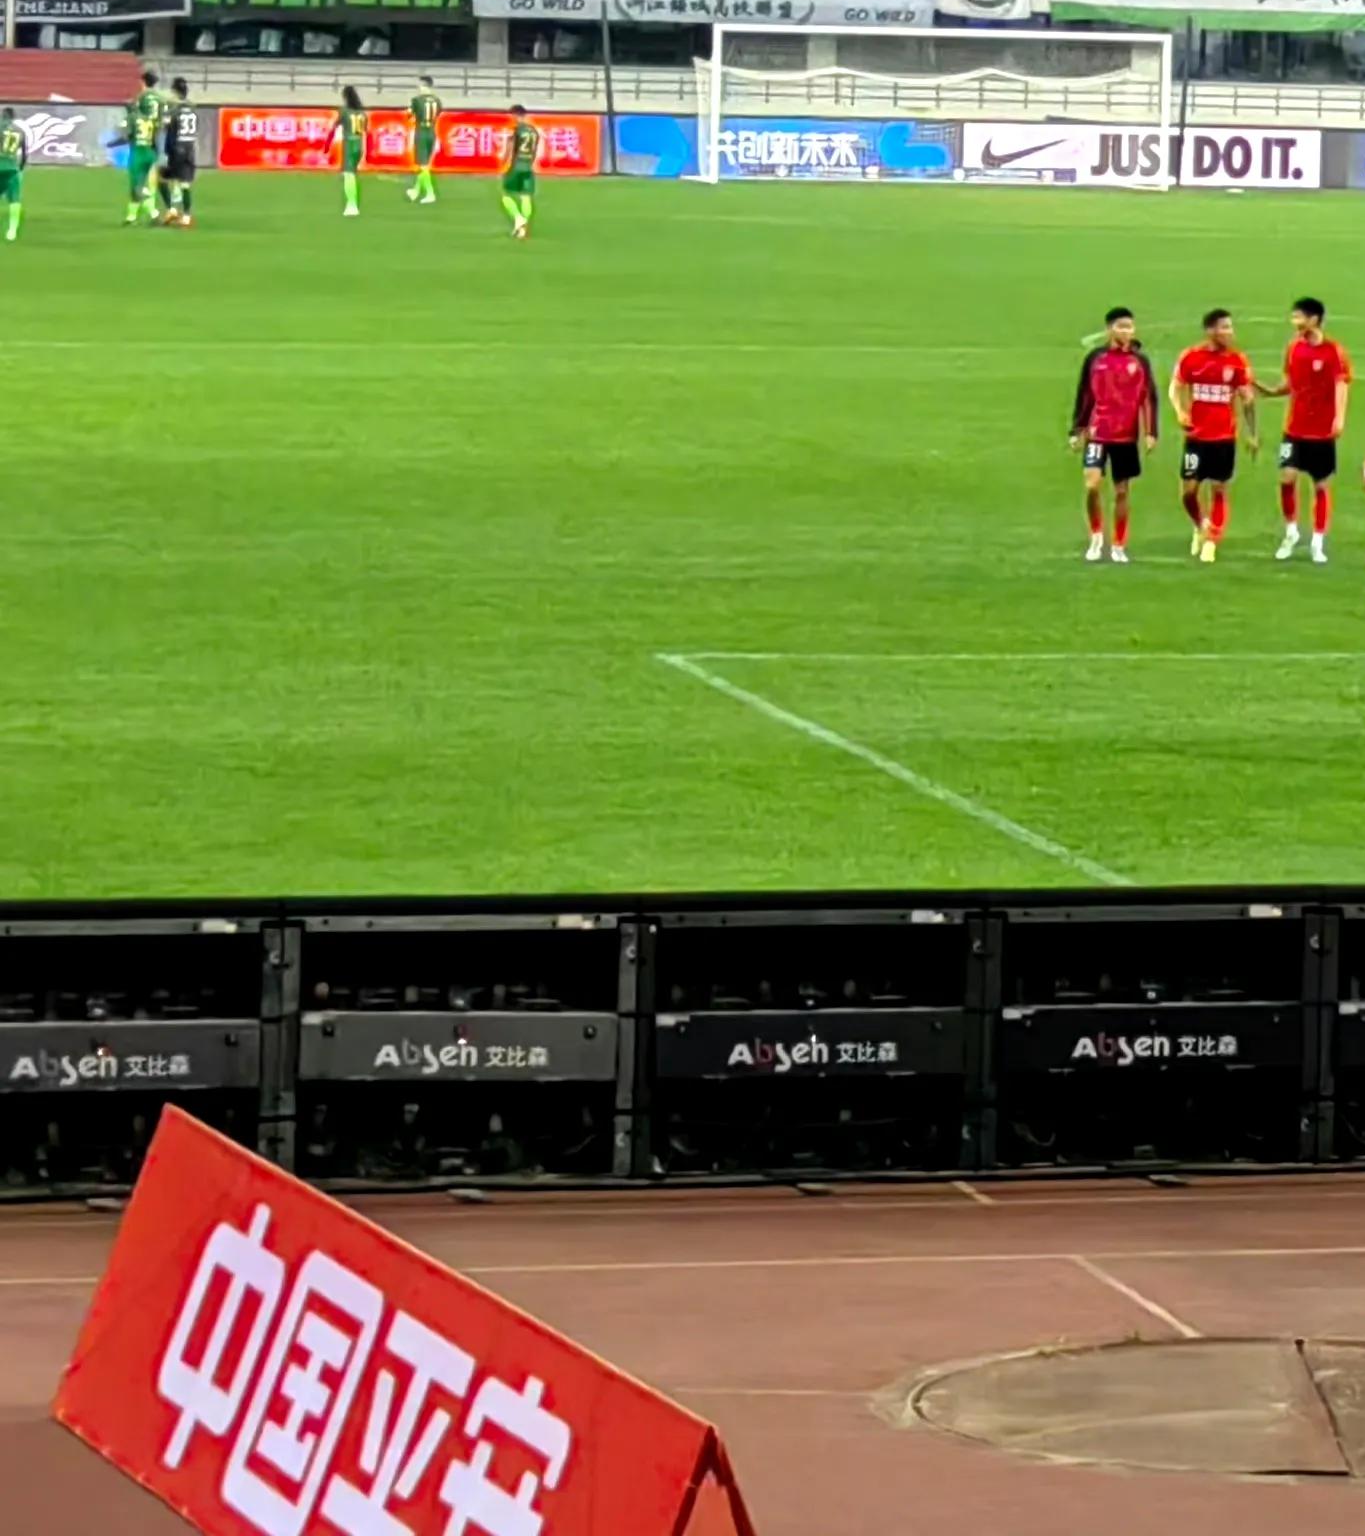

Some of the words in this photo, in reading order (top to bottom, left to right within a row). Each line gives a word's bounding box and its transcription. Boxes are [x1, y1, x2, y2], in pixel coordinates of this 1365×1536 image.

[844, 7, 872, 23] GO
[875, 8, 917, 23] WILD
[178, 114, 198, 135] 33
[43, 142, 84, 158] CSL
[1193, 135, 1252, 179] DO
[1261, 136, 1304, 180] IT.
[155, 1202, 572, 1536] 中国平安
